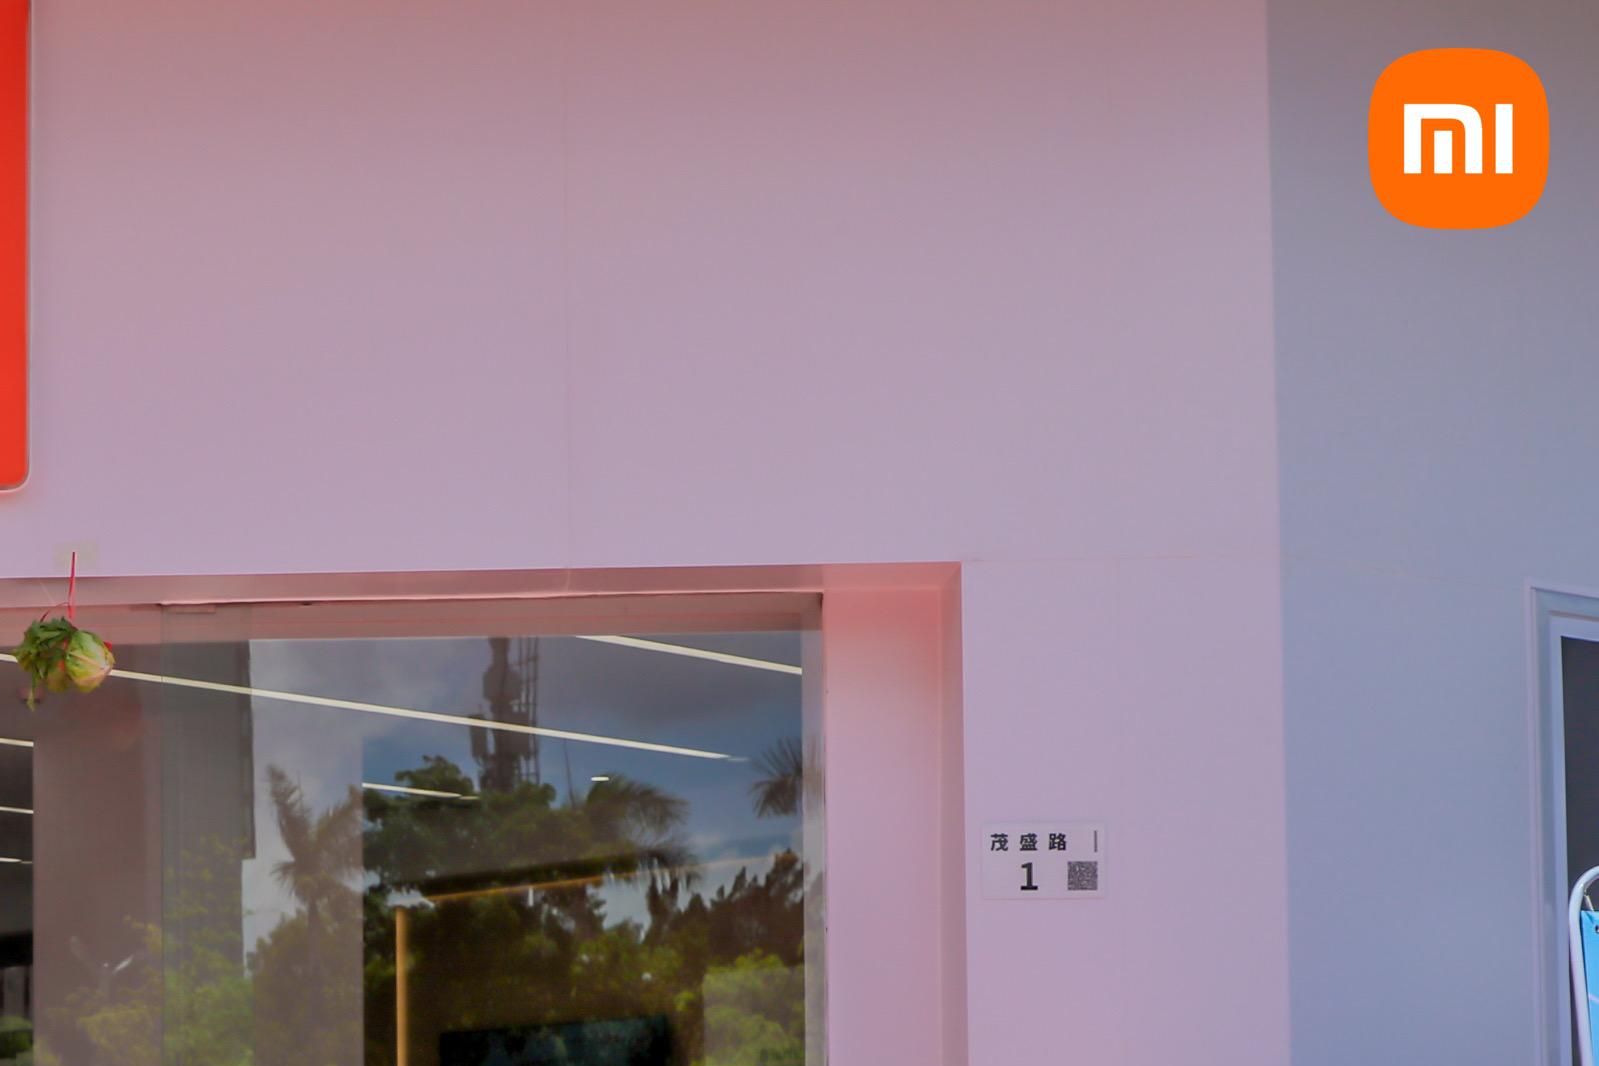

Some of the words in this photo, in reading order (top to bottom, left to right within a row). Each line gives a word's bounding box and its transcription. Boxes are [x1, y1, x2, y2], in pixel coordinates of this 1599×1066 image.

[990, 833, 1067, 851] 茂盛路
[1020, 862, 1038, 891] 1
